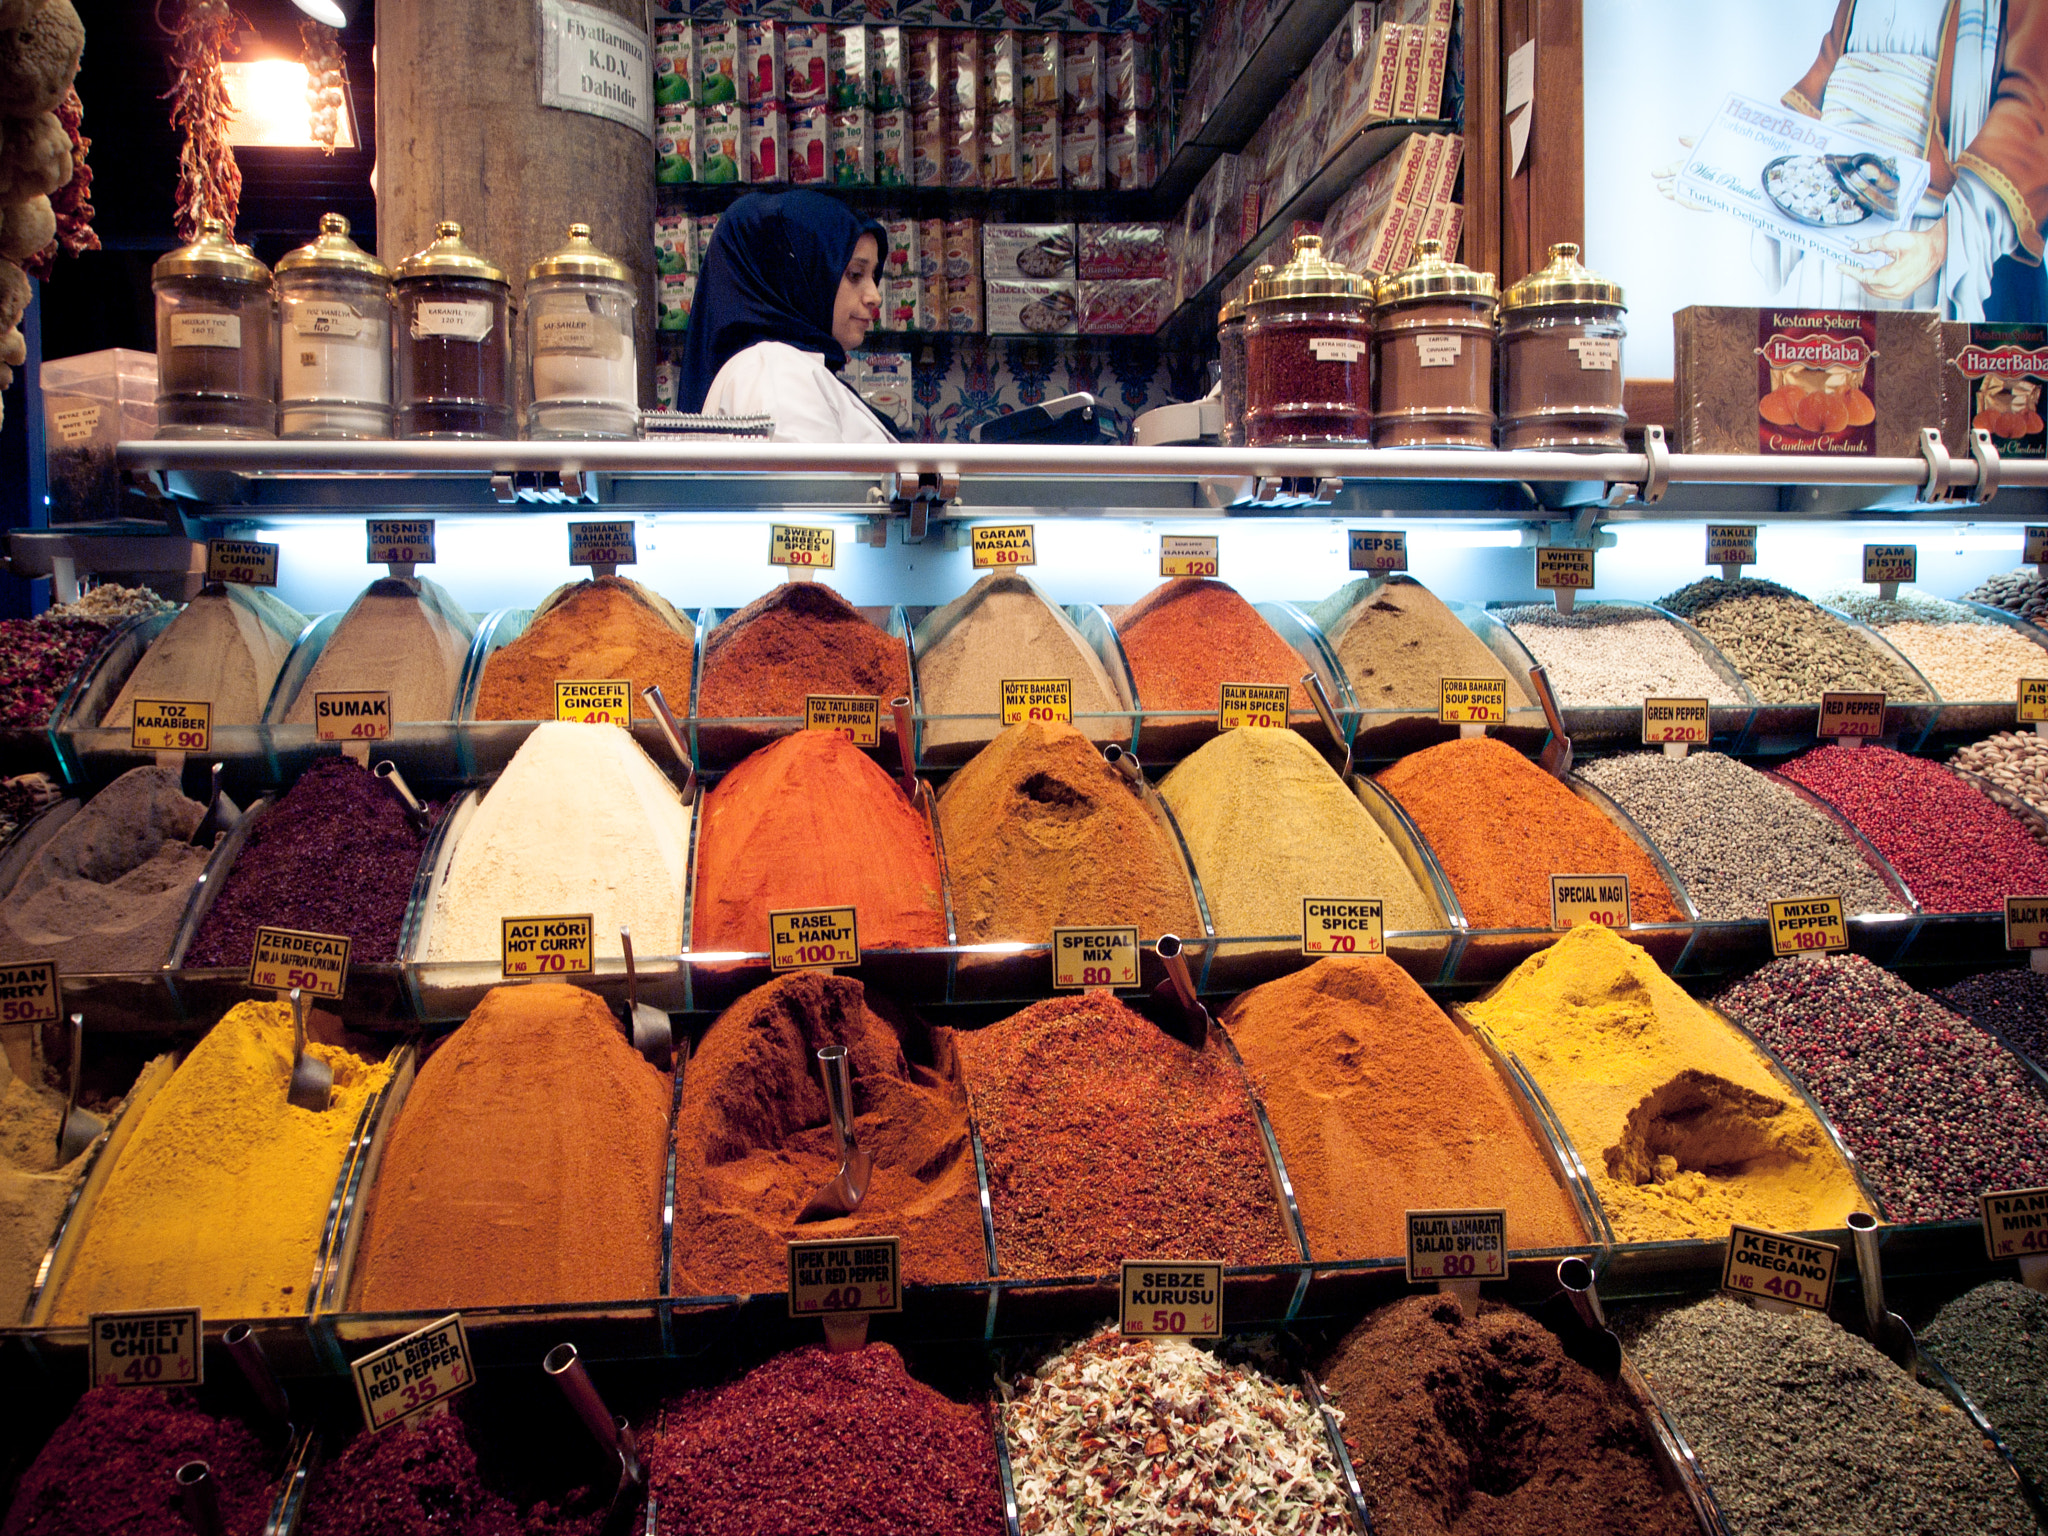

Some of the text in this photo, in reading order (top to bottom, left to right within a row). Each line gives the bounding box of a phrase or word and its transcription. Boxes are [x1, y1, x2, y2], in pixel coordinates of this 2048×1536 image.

[589, 49, 631, 80] K.D.V.
[1399, 29, 1424, 114] HazerBaba
[582, 74, 637, 109] Dahildir
[847, 128, 861, 136] Tea
[1726, 99, 1829, 150] HazerBaba
[886, 129, 900, 138] Tea
[1754, 132, 1792, 153] Delight
[1397, 139, 1427, 204] HazerBaba
[1417, 138, 1444, 204] HazerBaba
[1436, 139, 1463, 204] HazerBaba
[1687, 187, 1864, 269] Turkish Delight with Pistachio
[1372, 207, 1404, 272] HazerBaba
[1392, 207, 1423, 272] HazerBaba
[1773, 313, 1861, 331] Kestane Şekeri
[1774, 342, 1861, 362] HazerBaba
[1967, 354, 2048, 371] HazerBaba
[1769, 434, 1868, 452] Candied Chestnuts
[776, 535, 830, 545] BARBECU
[784, 528, 823, 537] SWEET
[980, 529, 1026, 540] GARAM
[1711, 528, 1754, 538] KAKULE
[975, 539, 1031, 550] MASALA
[1352, 538, 1403, 551] KEPSE
[1710, 538, 1754, 547] CARDAMON
[588, 548, 617, 560] 100
[790, 551, 812, 564] 90
[996, 550, 1019, 563] 80
[1547, 552, 1585, 562] WHITE
[1723, 549, 1746, 562] 180
[1875, 547, 1905, 559] ÇAM
[1186, 561, 1215, 575] 120
[1377, 557, 1395, 569] 90
[1541, 561, 1590, 573] PEPPER
[1868, 558, 1913, 567] FISTIK
[229, 566, 254, 580] 40
[1552, 572, 1579, 586] 150
[1886, 566, 1912, 580] 220
[1005, 683, 1068, 694] KÖFTE BAHARATI
[1225, 687, 1286, 701] BALIK BAHARATI
[1444, 681, 1505, 693] ÇORBA BAHARATI
[564, 697, 623, 709] GINGER
[811, 700, 827, 711] TOZ
[828, 701, 850, 712] TATLI
[1006, 694, 1067, 705] MIX SPICES
[1225, 700, 1286, 712] FISH SPICES
[1445, 694, 1502, 704] SOUP SPICES
[159, 705, 186, 717] TOZ
[318, 700, 387, 717] SUMAK
[1029, 707, 1054, 721] 60
[1467, 706, 1489, 720] 70
[1648, 706, 1706, 721] GREEN PEPPER
[1825, 701, 1880, 716] RED PEPPER
[583, 711, 610, 724] 40
[813, 712, 872, 725] SWET PAPRICA
[1246, 713, 1271, 728] 70
[351, 722, 376, 738] 40
[1663, 727, 1695, 741] 220
[1839, 722, 1869, 735] 220
[177, 731, 204, 748] 90
[1558, 885, 1623, 904] SPECIAL MAGI
[1309, 904, 1381, 917] CHICKEN
[1589, 910, 1614, 927] 90
[1784, 903, 1830, 918] MIXED
[2011, 908, 2038, 924] BLACK
[790, 914, 837, 929] RASEL
[1322, 918, 1369, 930] SPICE
[1778, 915, 1839, 931] PEPPER
[511, 925, 540, 938] ACI
[776, 927, 852, 945] EL HANUT
[262, 934, 342, 956] ZERDEÇAL
[508, 938, 587, 953] HOT CURRY
[1062, 935, 1132, 949] SPECIAL
[1329, 935, 1356, 952] 70
[1793, 931, 1828, 950] 180
[795, 944, 853, 964] 100 TL
[535, 953, 586, 973] 70 TL
[287, 969, 318, 990] 50
[1083, 966, 1111, 985] 80
[3, 1000, 34, 1021] 50
[1413, 1218, 1500, 1236] SALATA BAHARATI
[1415, 1235, 1499, 1253] SALAD SPICES
[2021, 1229, 2048, 1251] 40
[828, 1250, 852, 1267] PUL
[1443, 1254, 1476, 1276] 80
[1735, 1250, 1827, 1282] OREGANO
[825, 1268, 847, 1285] RED
[849, 1265, 890, 1283] PEPPER
[1142, 1272, 1205, 1289] SEBZE
[1764, 1275, 1803, 1300] 40
[822, 1286, 862, 1309] 40
[1132, 1289, 1215, 1305] KURUSU
[101, 1318, 189, 1341] SWEET
[1152, 1310, 1187, 1333] 50
[110, 1336, 179, 1358] CHILI
[123, 1355, 163, 1383] 40
[369, 1345, 462, 1402] RED PEPPER
[372, 1356, 403, 1381] PUL
[400, 1376, 438, 1409] 35
